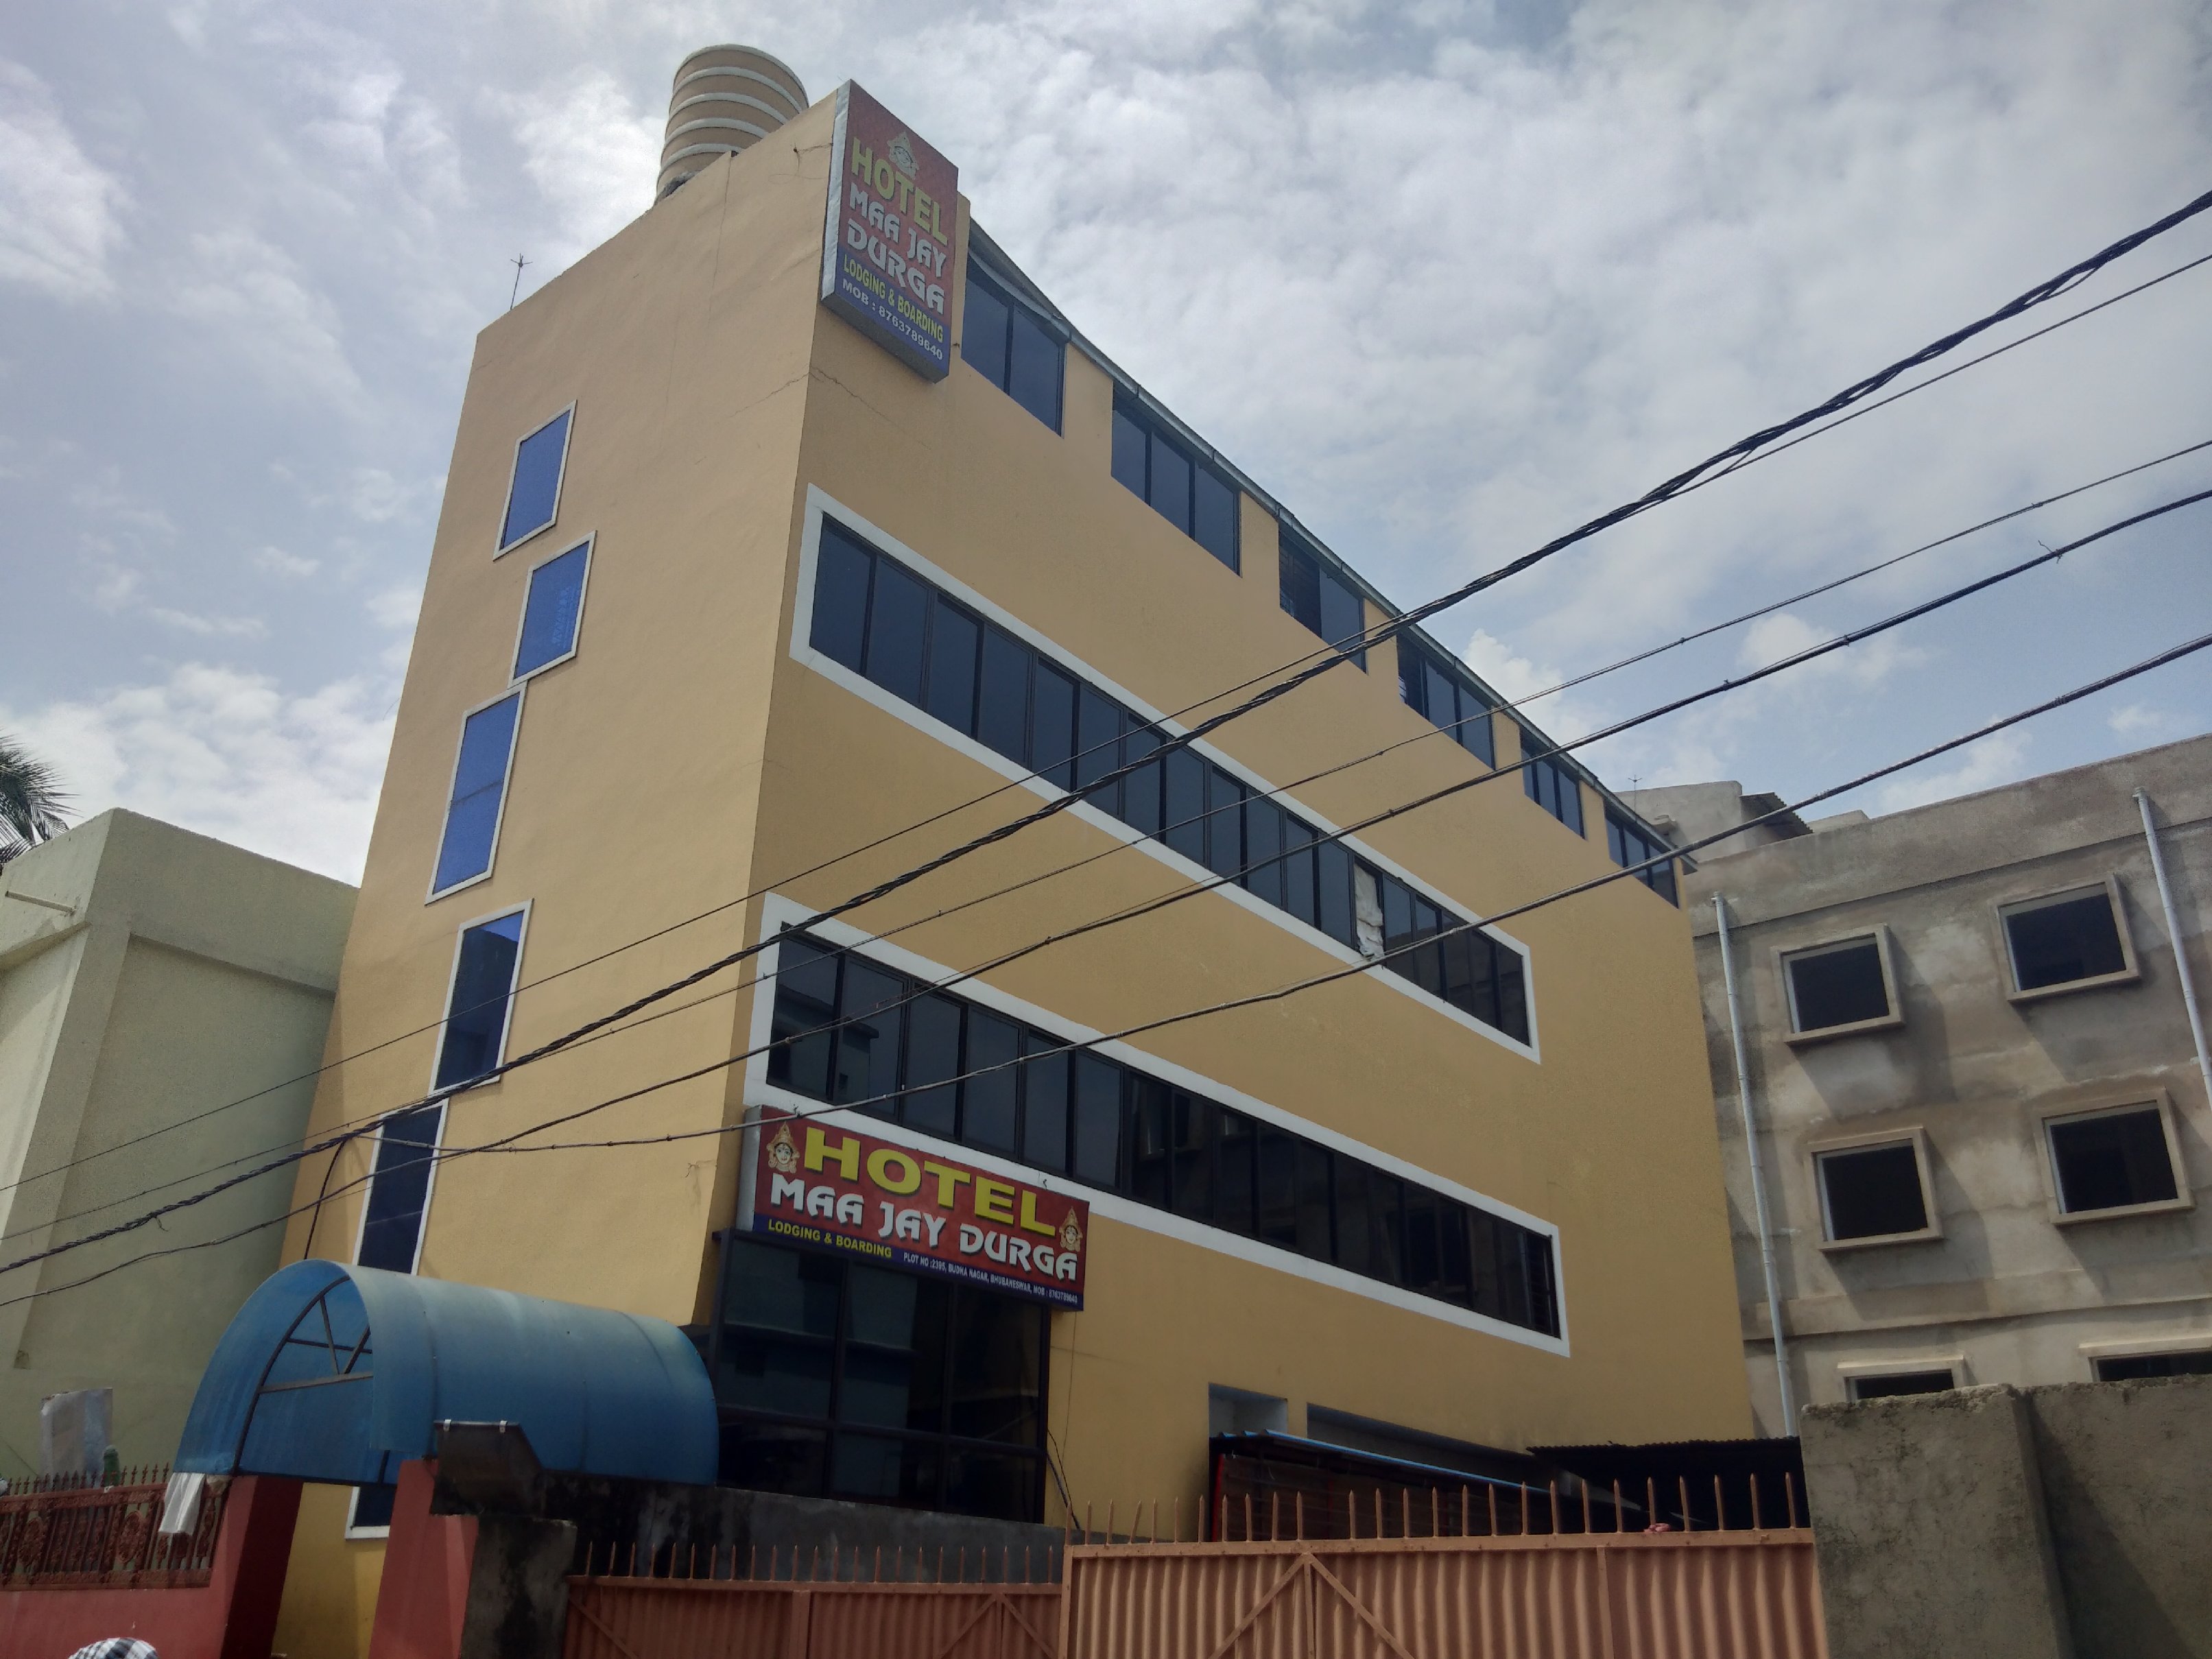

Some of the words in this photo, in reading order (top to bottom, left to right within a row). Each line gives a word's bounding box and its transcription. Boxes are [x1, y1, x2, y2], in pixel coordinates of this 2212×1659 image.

[849, 182, 900, 240] MAA
[907, 228, 947, 278] JAY
[851, 137, 949, 246] HOTEL
[844, 254, 885, 299] LODGING
[888, 288, 895, 307] &
[897, 296, 944, 342] BOARDING
[847, 219, 944, 315] DURGA
[842, 278, 869, 305] MOB
[878, 306, 943, 360] 8763789640
[770, 1173, 864, 1226] MAA
[878, 1201, 946, 1250] JAY
[960, 1224, 1078, 1281] DURGA
[804, 1126, 1056, 1237] HOTEL
[768, 1219, 820, 1241] LODGING
[824, 1232, 833, 1245] &
[835, 1235, 892, 1258] BOARDING
[903, 1252, 919, 1264] PLOT
[920, 1256, 929, 1267] NO
[1033, 1285, 1045, 1296] MOB
